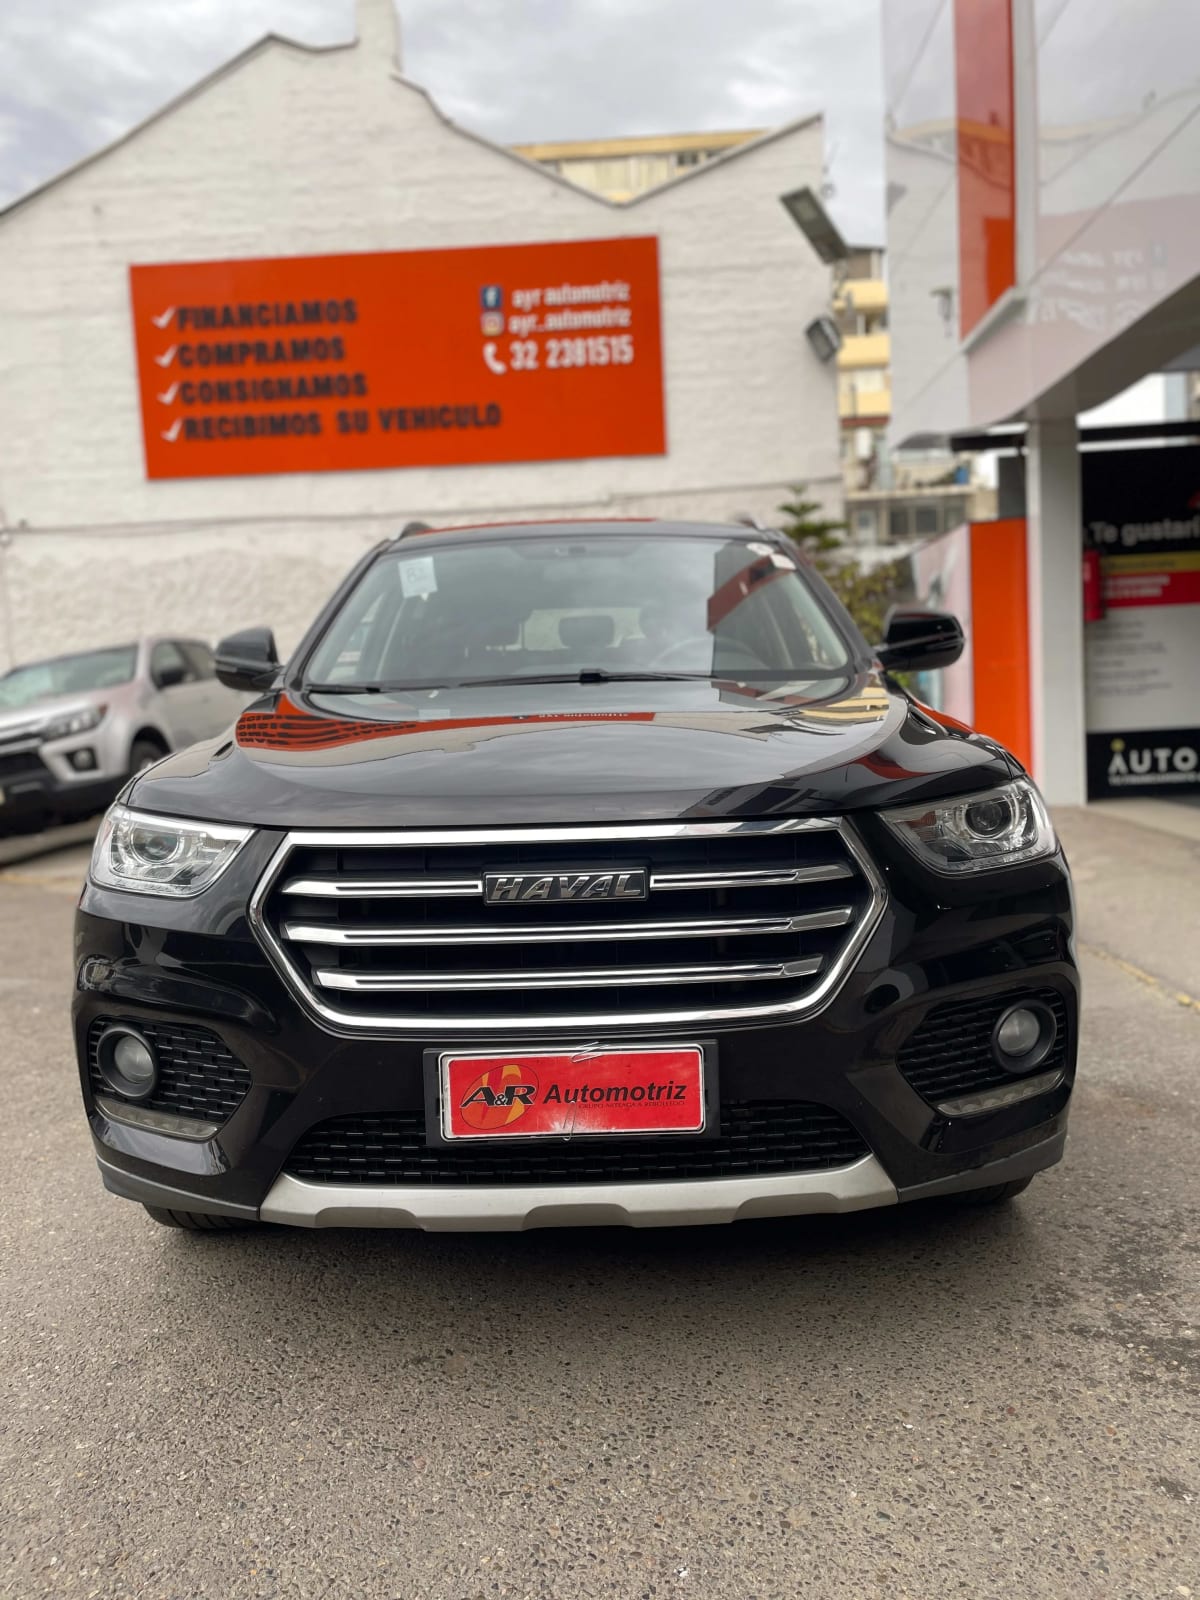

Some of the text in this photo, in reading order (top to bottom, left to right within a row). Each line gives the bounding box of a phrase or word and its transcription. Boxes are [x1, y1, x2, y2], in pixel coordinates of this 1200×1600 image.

[512, 280, 631, 312] ayr automotriz
[177, 298, 358, 331] FINANCIAMOS
[178, 335, 346, 368] COMPRAMOS
[510, 334, 634, 371] 32 2381515
[180, 372, 368, 405] CONSIGNAMOS
[184, 403, 503, 441] RECIBIMOS SU VEHICULO
[1108, 746, 1199, 775] AUTO
[491, 874, 641, 900] HAVAL
[459, 1080, 688, 1108] A&R Automotriz
